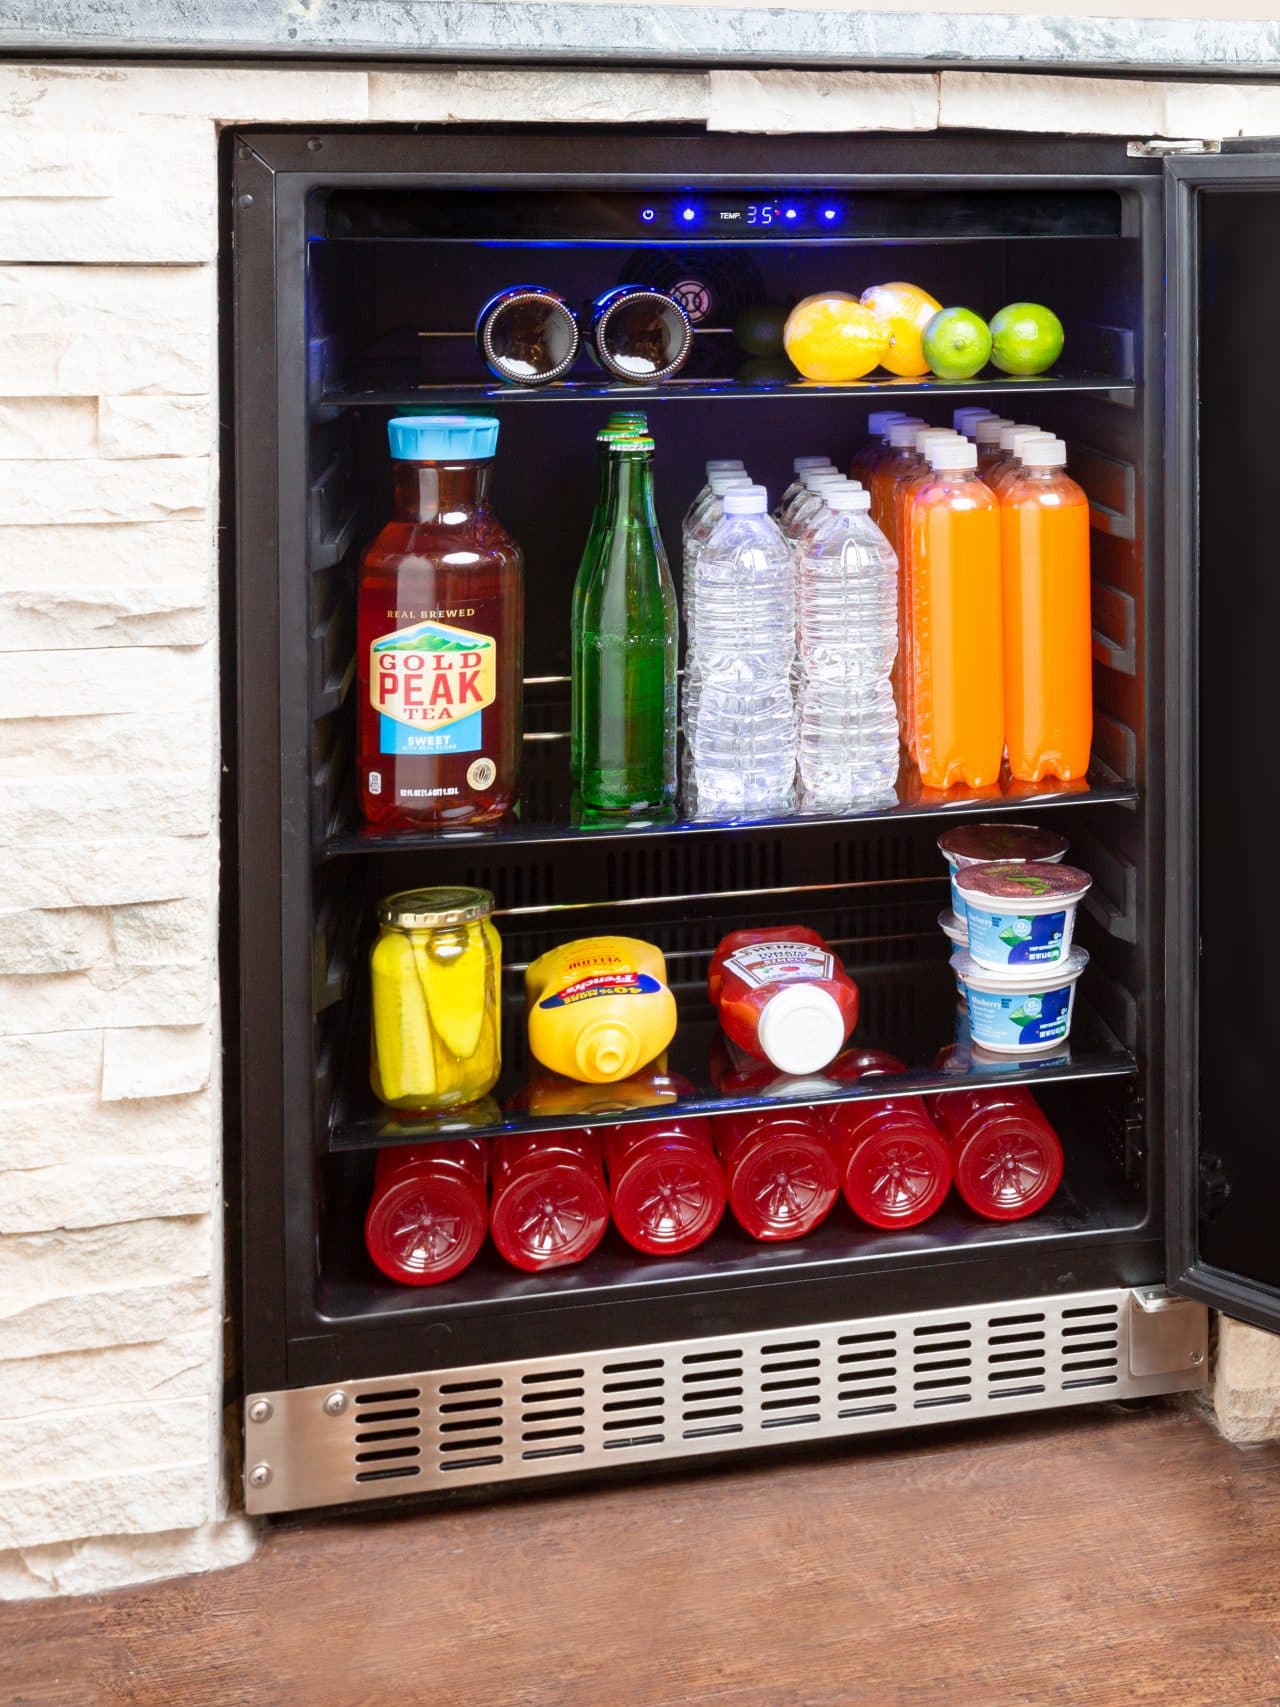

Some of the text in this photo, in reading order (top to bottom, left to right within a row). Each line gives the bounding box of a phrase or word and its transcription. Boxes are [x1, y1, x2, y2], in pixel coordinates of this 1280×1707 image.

[719, 206, 772, 224] TEMP. 35
[387, 608, 475, 619] REAL BREWED
[379, 652, 482, 671] GOLD
[379, 670, 484, 706] PEAK
[403, 707, 454, 720] TEA
[407, 735, 451, 746] SWEET
[565, 974, 635, 994] French's
